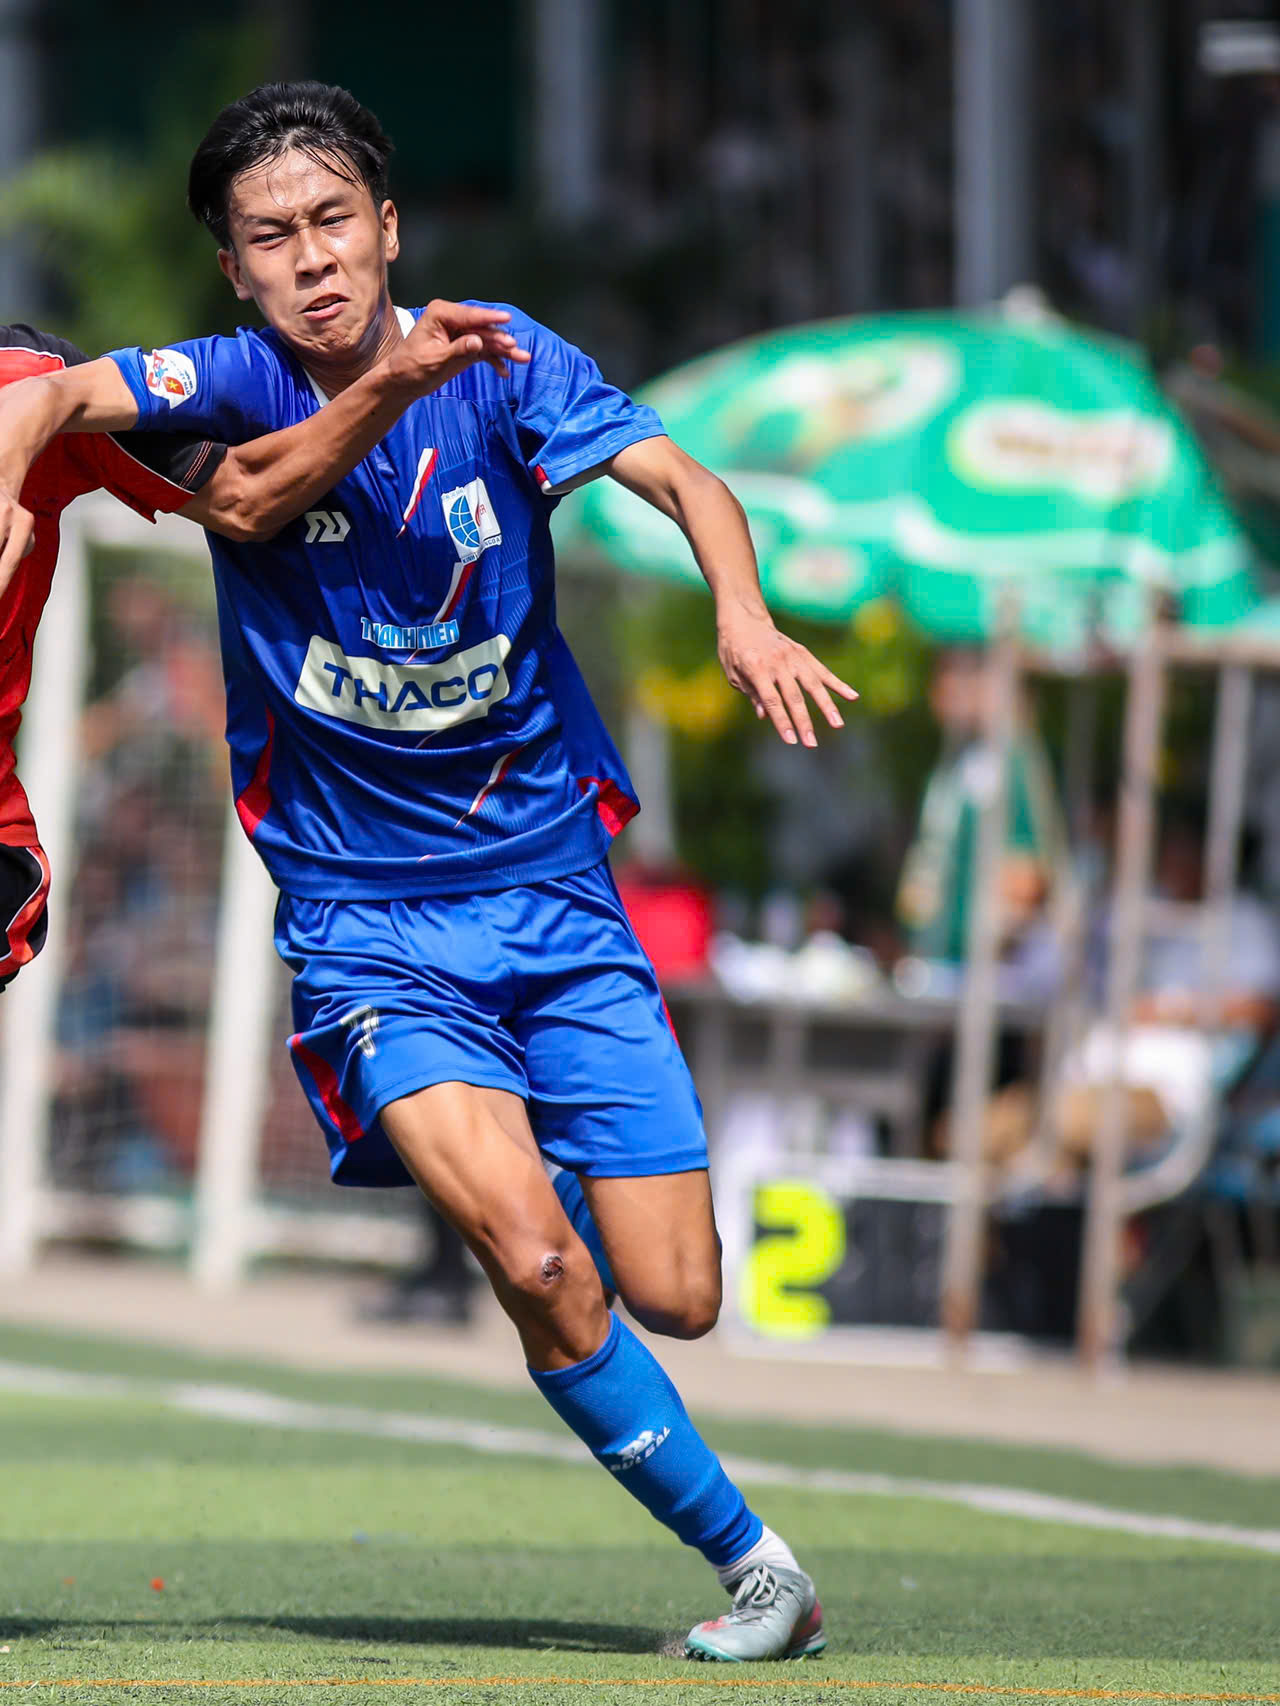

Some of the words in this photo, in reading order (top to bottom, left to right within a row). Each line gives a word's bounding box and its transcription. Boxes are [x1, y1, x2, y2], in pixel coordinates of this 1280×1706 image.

[361, 616, 416, 649] THANH
[323, 661, 499, 713] THACO
[739, 1180, 847, 1342] 2
